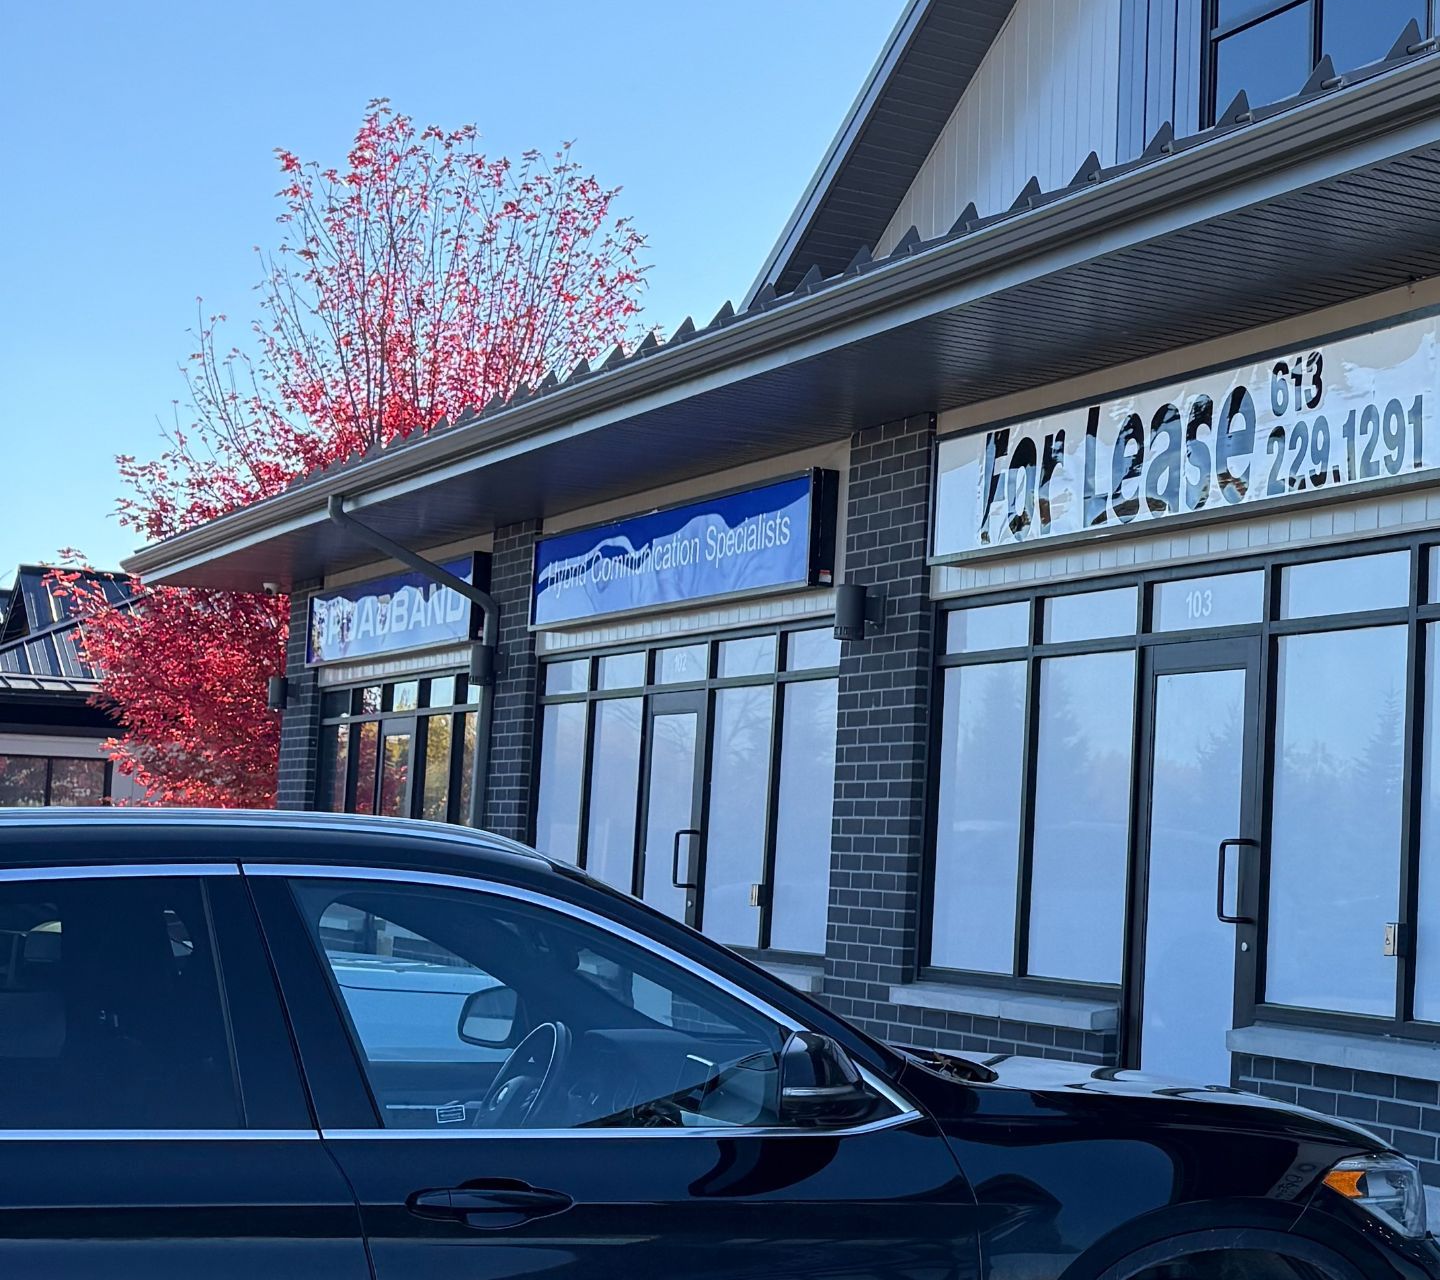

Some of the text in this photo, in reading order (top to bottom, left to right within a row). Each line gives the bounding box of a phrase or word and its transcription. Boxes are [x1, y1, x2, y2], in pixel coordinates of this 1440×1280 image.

[1270, 350, 1324, 417] 613
[980, 385, 1257, 545] For Lease
[1266, 394, 1424, 496] 229.1291
[548, 512, 791, 599] Hybrid Communication Specialists
[1185, 589, 1213, 619] 103
